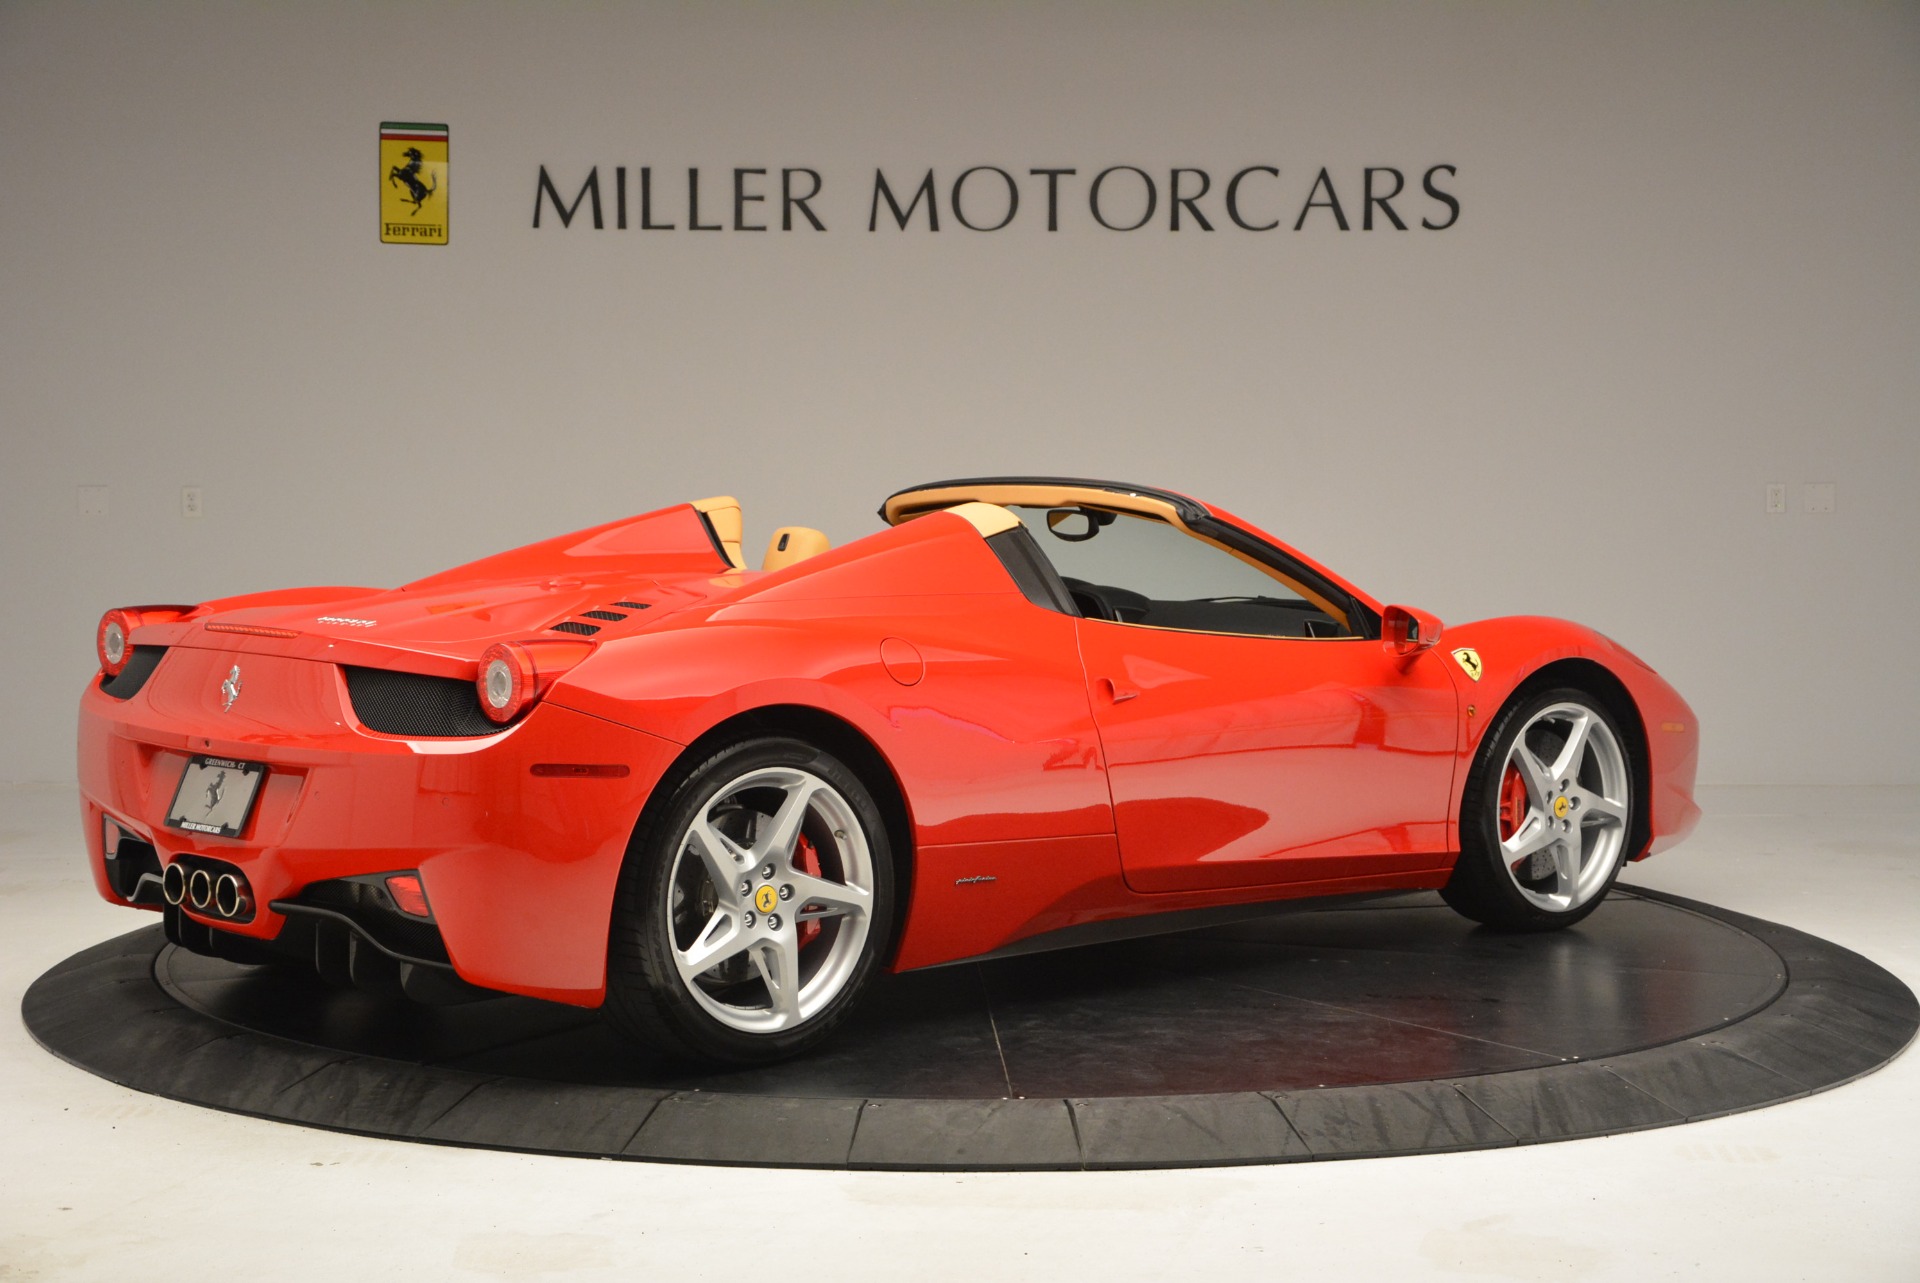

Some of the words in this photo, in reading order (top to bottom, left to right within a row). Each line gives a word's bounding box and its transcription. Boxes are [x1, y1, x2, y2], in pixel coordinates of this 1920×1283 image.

[532, 165, 826, 231] MILLER
[869, 164, 1460, 232] MOTORCARS
[384, 222, 442, 237] Ferrari
[181, 821, 197, 830] MILLER
[197, 824, 222, 834] MOTORCARS
